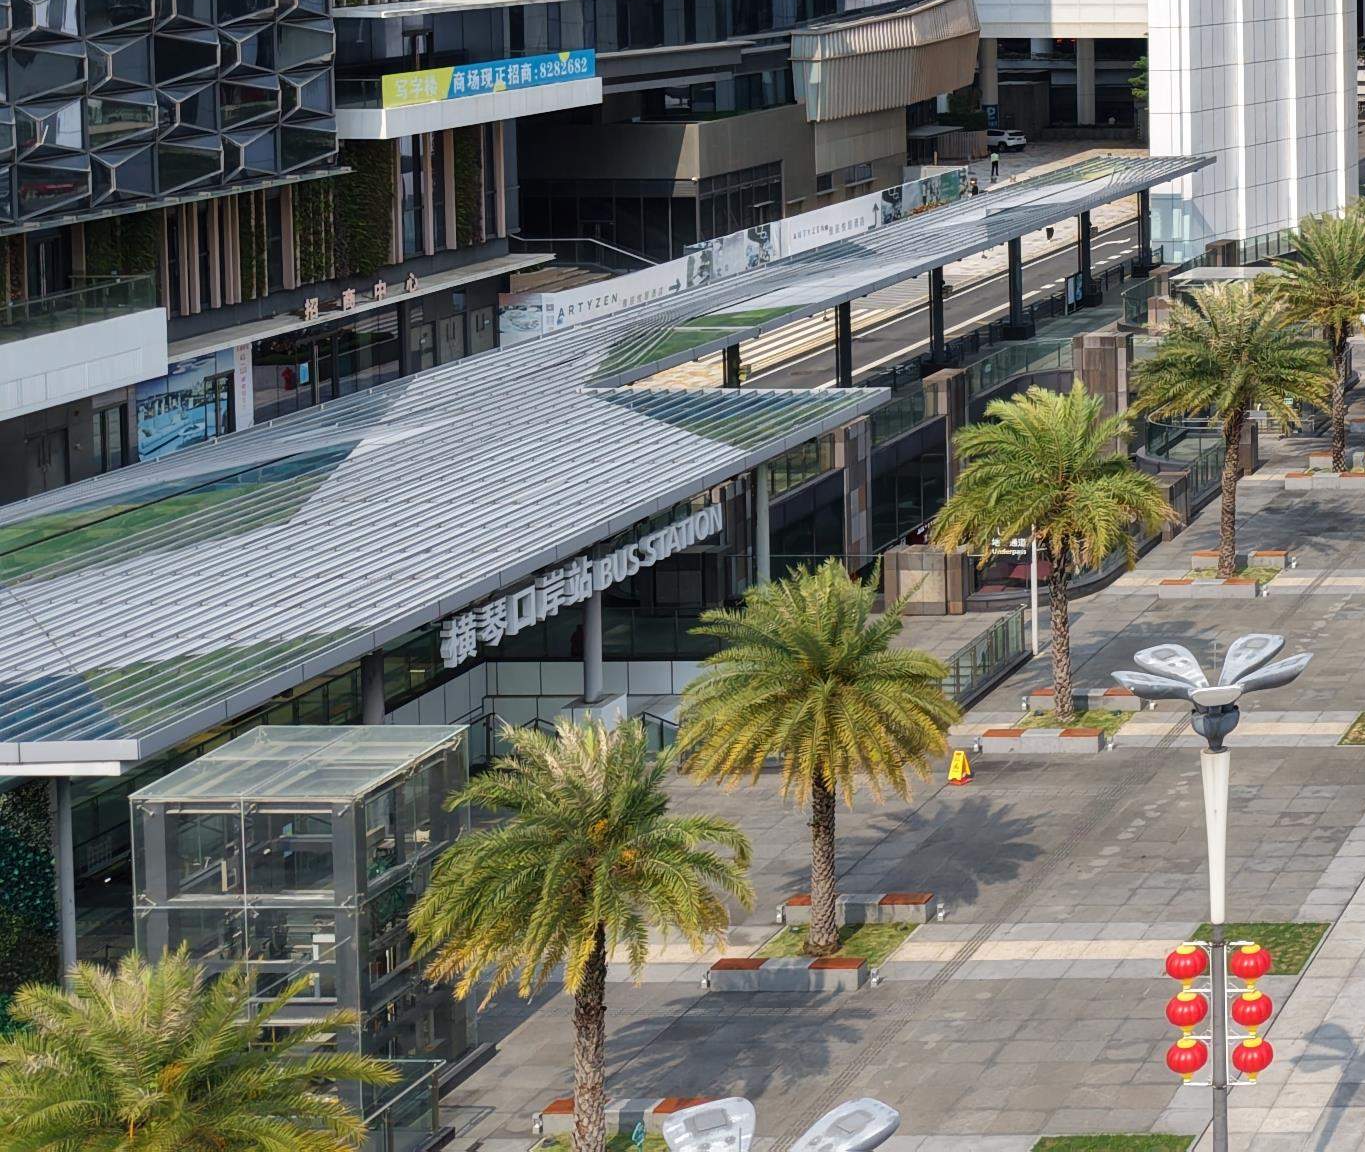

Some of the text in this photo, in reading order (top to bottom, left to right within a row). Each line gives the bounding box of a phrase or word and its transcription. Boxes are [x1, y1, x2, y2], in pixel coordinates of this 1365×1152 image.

[304, 272, 419, 321] 招商中心
[557, 293, 619, 320] ARTYZEN
[595, 502, 723, 591] BUS STATION
[440, 555, 594, 668] 横琴口岸站
